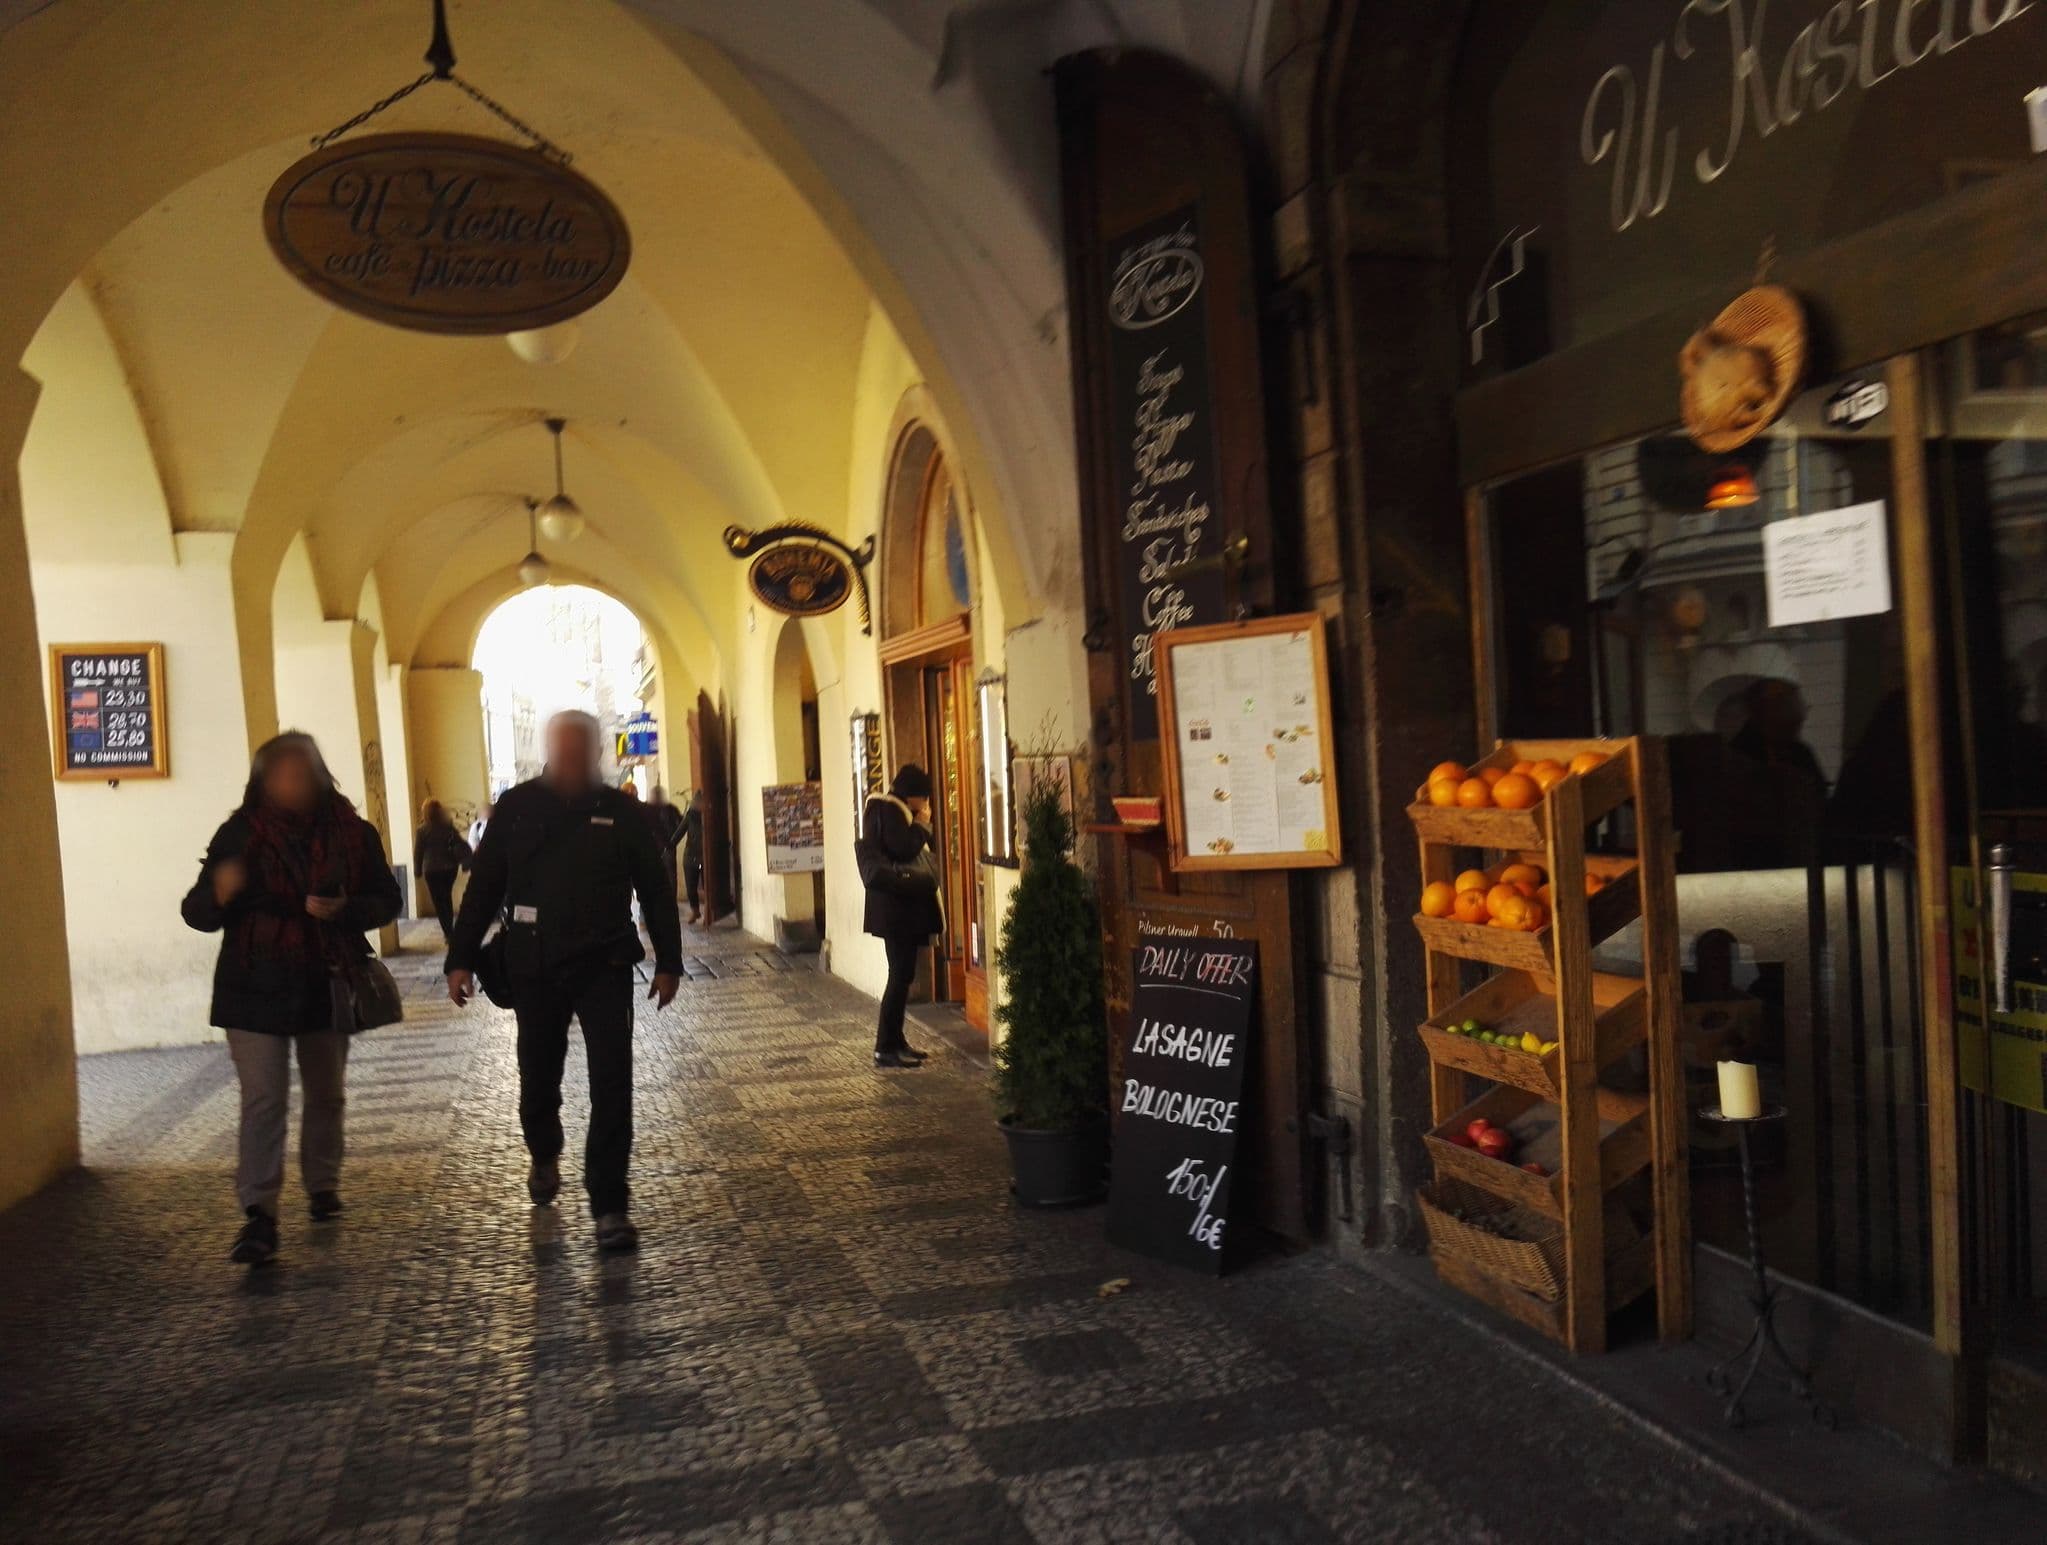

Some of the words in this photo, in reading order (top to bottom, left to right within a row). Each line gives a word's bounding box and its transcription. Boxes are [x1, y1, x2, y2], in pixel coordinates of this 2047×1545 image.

[409, 247, 521, 297] pizza
[543, 247, 600, 282] bar
[1142, 583, 1195, 633] Coffee
[71, 659, 141, 677] CHANGE
[105, 690, 146, 708] 23,30
[74, 752, 87, 763] NO
[91, 750, 149, 763] COMMISSION
[1138, 919, 1167, 936] Pilsner
[1140, 945, 1196, 981] DAILY
[1196, 952, 1253, 985] OFFER
[1132, 1018, 1236, 1068] LASAGNE
[1121, 1079, 1239, 1133] BOLOGNESE
